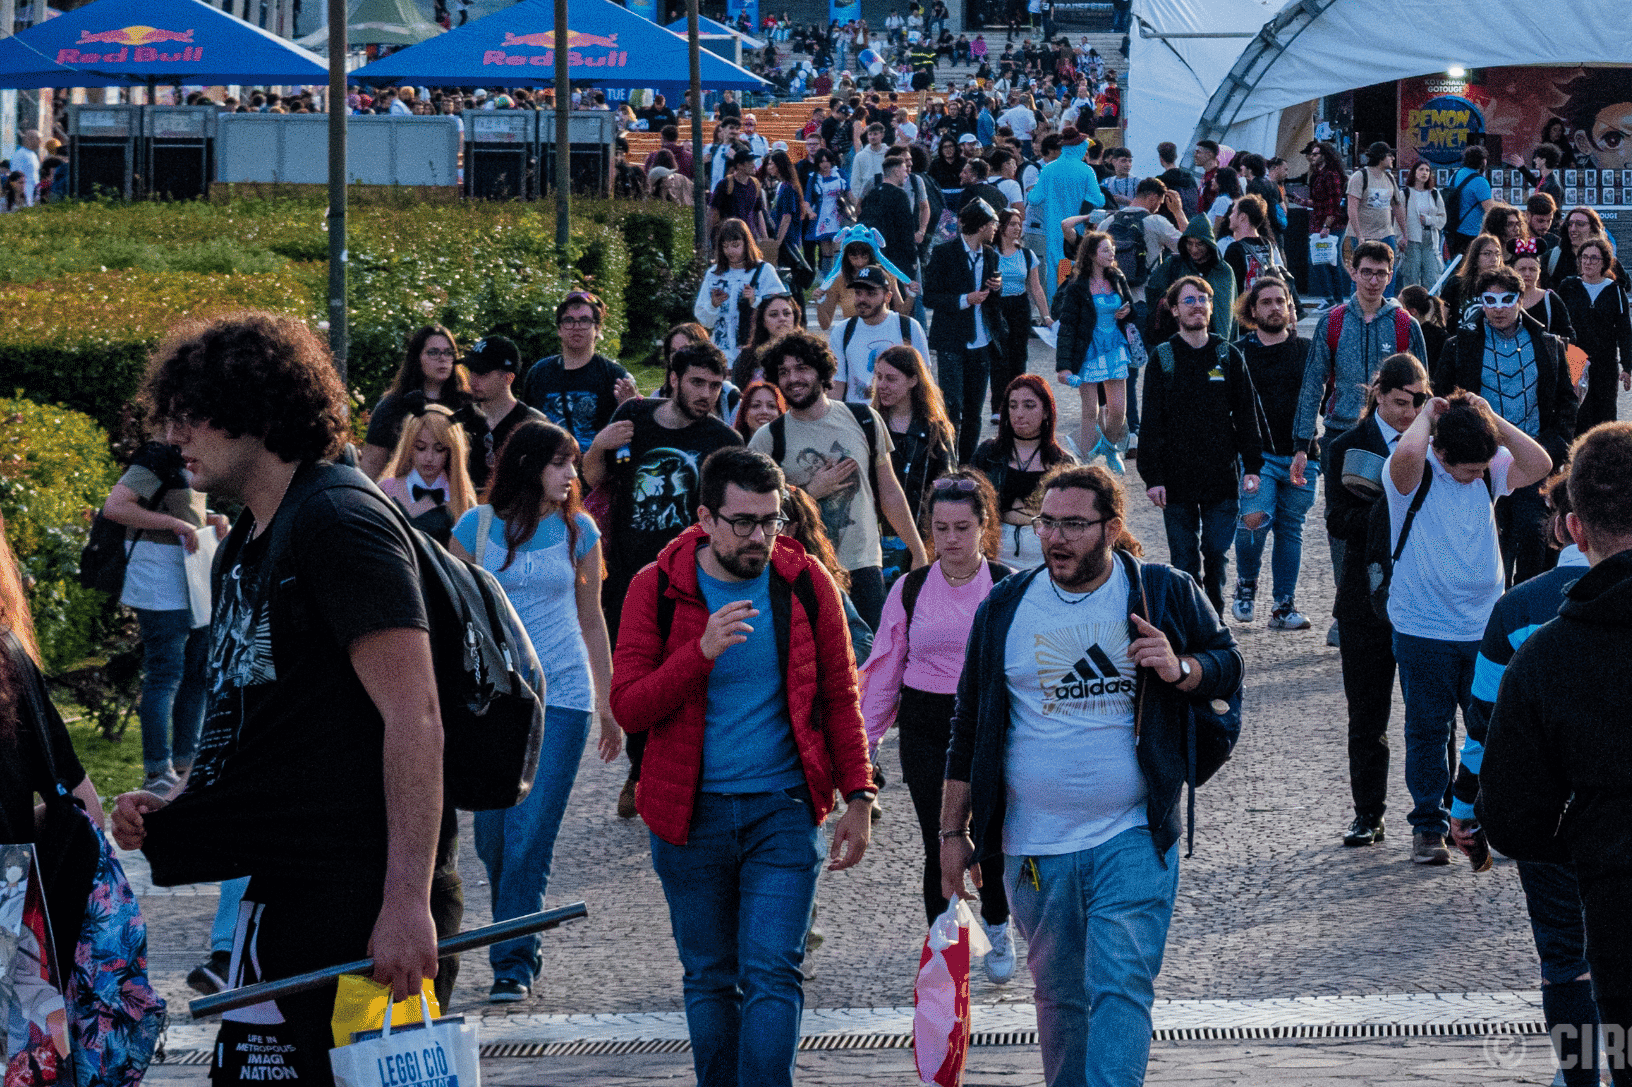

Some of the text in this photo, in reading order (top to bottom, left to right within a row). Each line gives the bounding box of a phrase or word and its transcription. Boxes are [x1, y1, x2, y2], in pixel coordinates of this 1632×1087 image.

[55, 46, 203, 64] Red Bull
[483, 50, 554, 66] Red
[1408, 109, 1471, 128] DEMON
[1055, 677, 1132, 700] adidas
[247, 1033, 278, 1044] LIFE IN
[235, 1042, 297, 1053] METROPOLIS
[247, 1053, 285, 1065] IMAGI
[377, 1040, 449, 1087] LEGGI CIÒ
[239, 1065, 299, 1081] NATION
